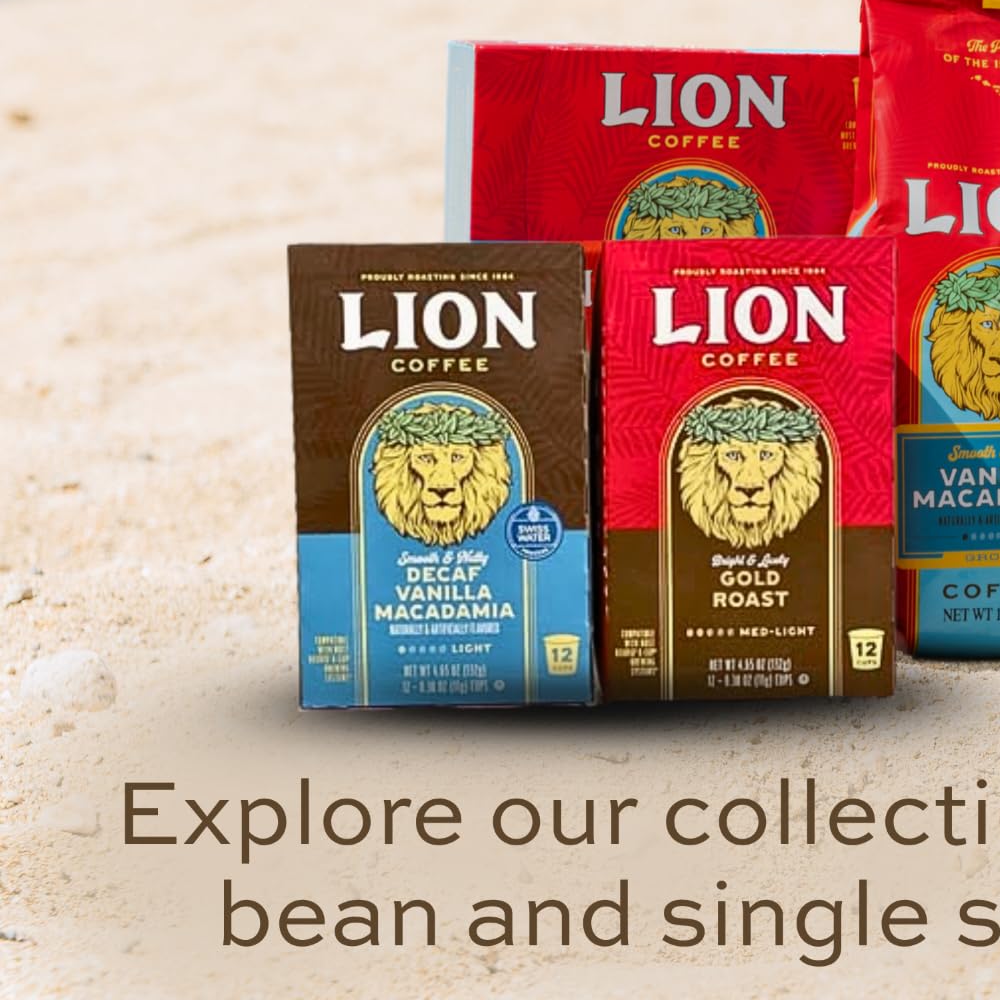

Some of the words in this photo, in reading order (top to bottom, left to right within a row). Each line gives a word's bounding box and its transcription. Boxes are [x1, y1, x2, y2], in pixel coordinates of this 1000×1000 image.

[967, 40, 987, 52] The
[944, 54, 959, 63] OF
[965, 57, 988, 68] THE
[601, 72, 789, 128] LION
[648, 135, 740, 149] COFFEE
[928, 162, 968, 172] PROUDLY
[339, 291, 537, 350] LION
[651, 286, 848, 346] LION
[391, 358, 489, 373] COFFEE
[702, 353, 798, 367] COFFEE
[948, 445, 995, 462] Smooth
[407, 567, 481, 582] DECAF
[720, 571, 780, 586] GOLD
[395, 585, 492, 600] VANILLA
[713, 591, 789, 607] ROAST
[374, 603, 516, 621] MACADAMIA
[943, 608, 968, 622] NET
[973, 608, 991, 621] WT
[740, 626, 816, 637] MED-LIGHT
[451, 644, 492, 654] LIGHT
[552, 648, 572, 662] 12
[856, 642, 876, 657] 12
